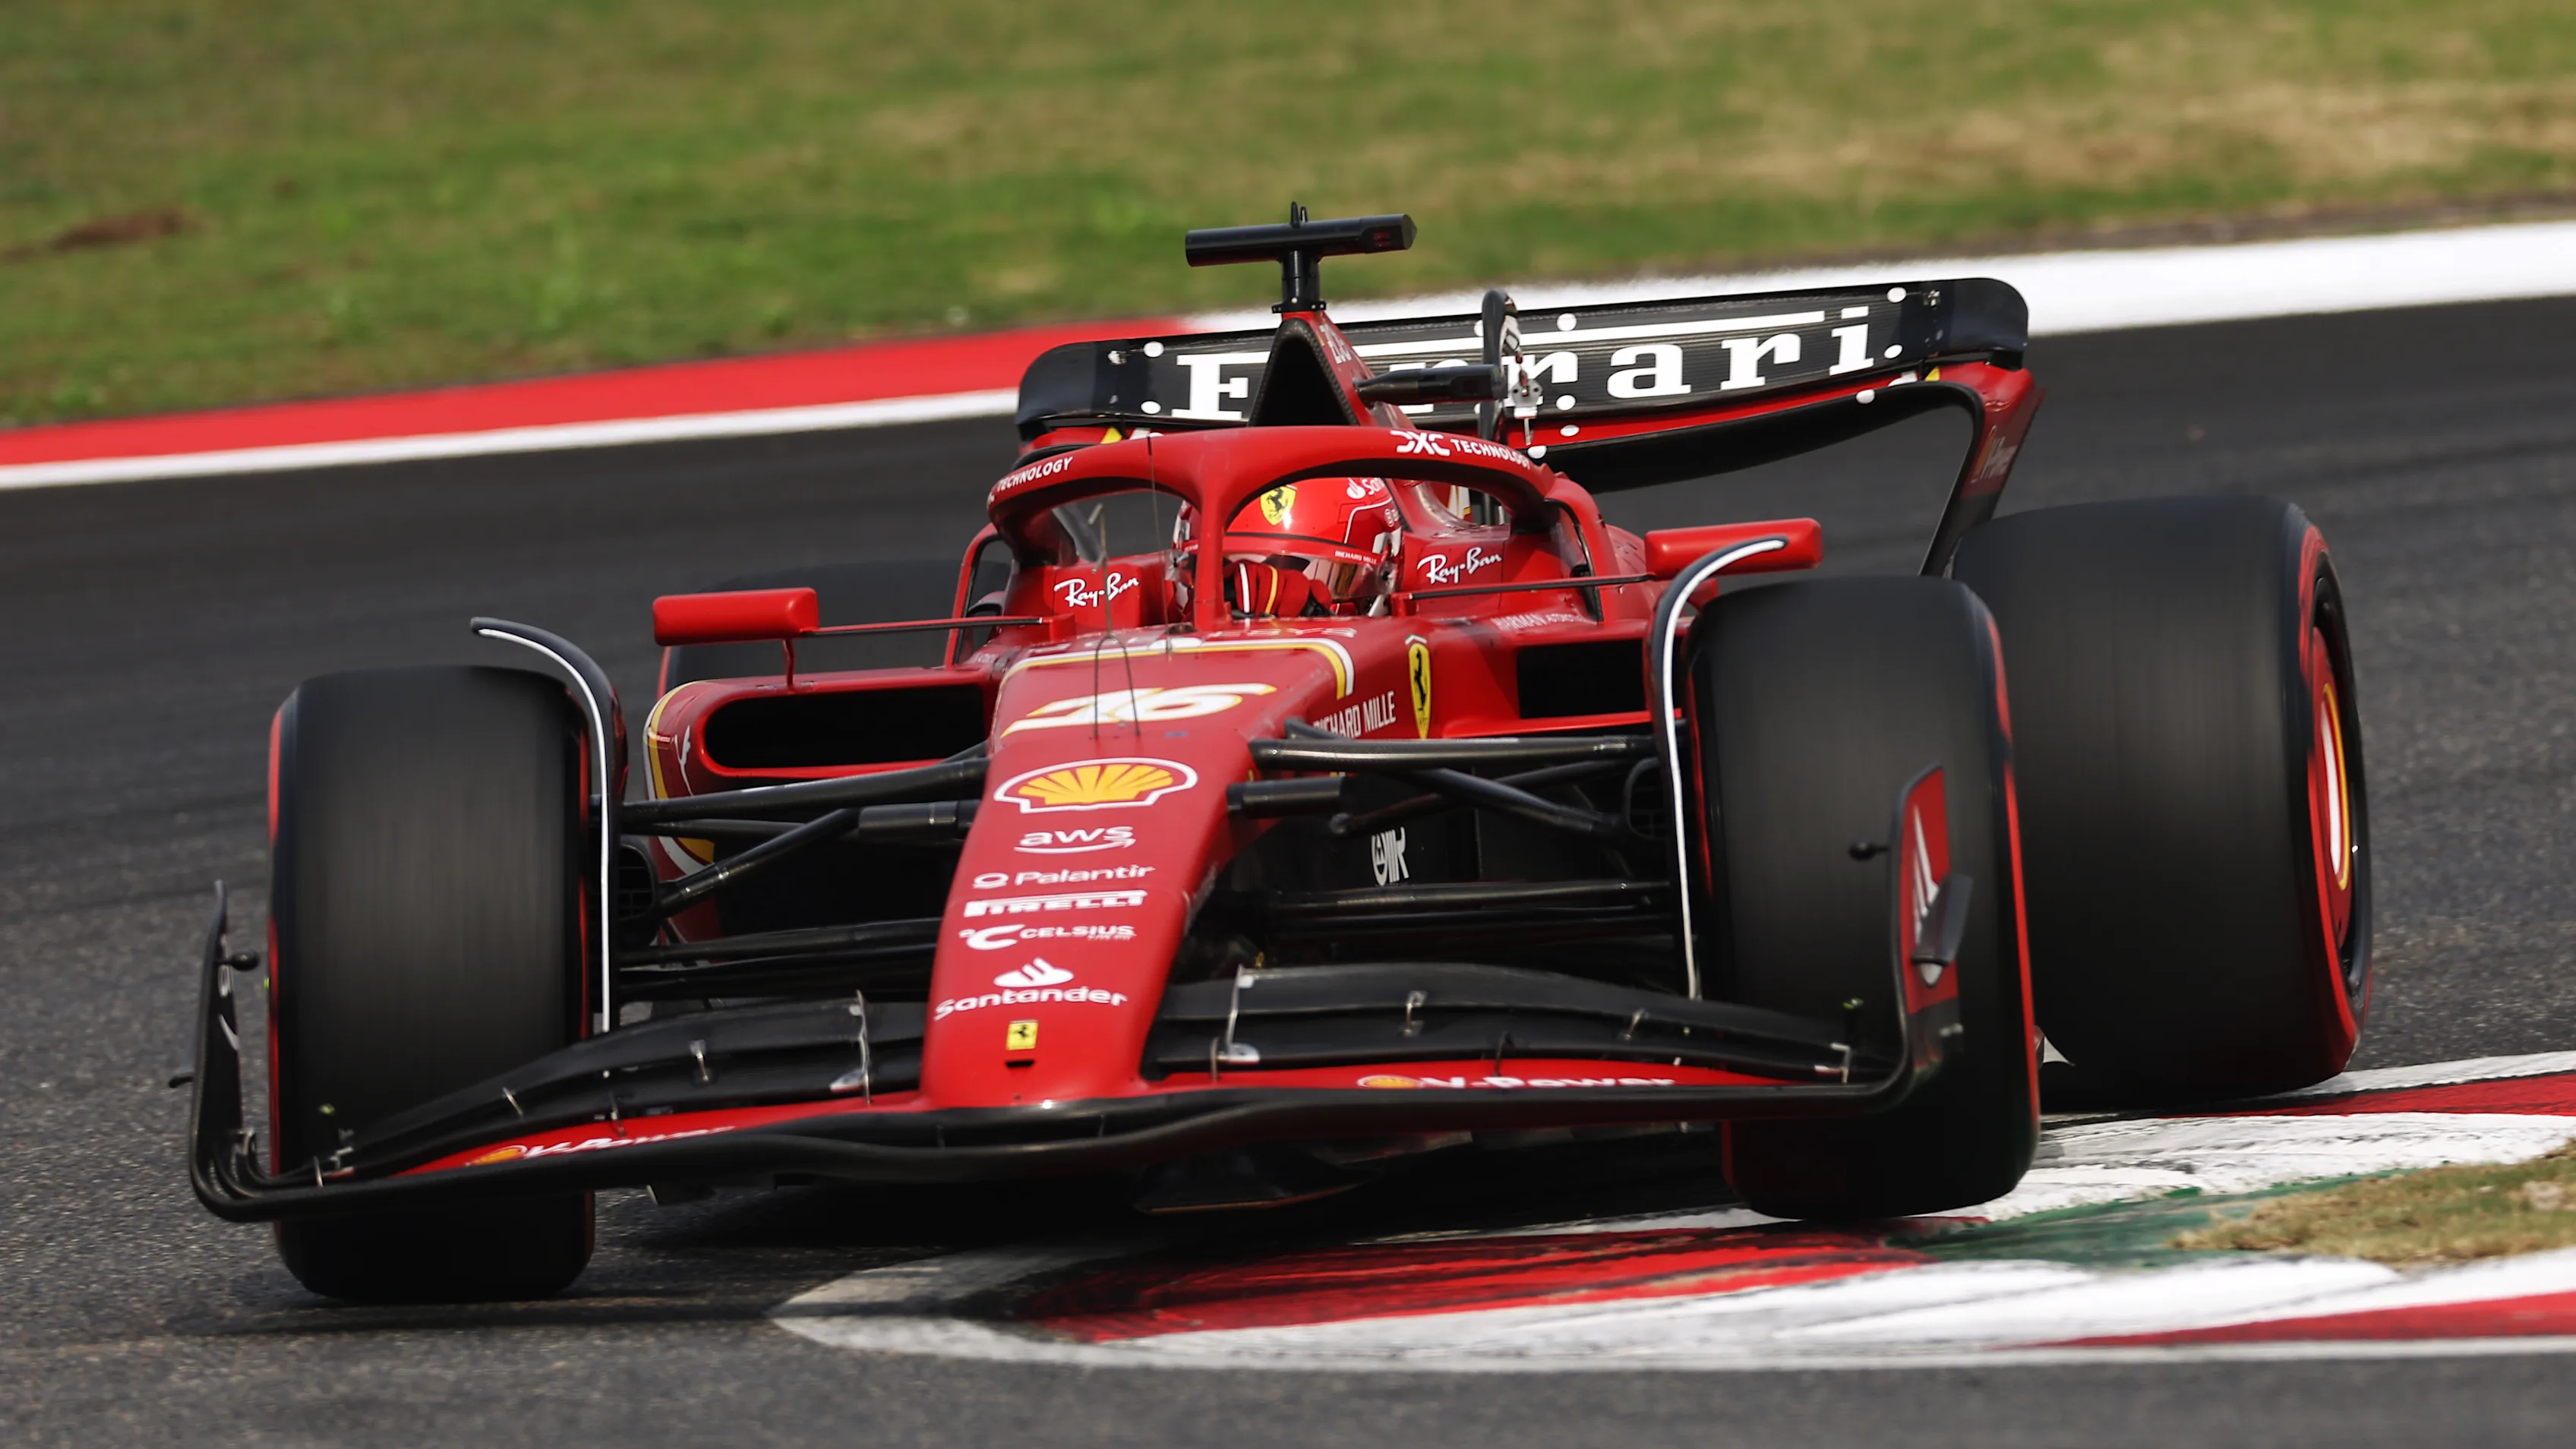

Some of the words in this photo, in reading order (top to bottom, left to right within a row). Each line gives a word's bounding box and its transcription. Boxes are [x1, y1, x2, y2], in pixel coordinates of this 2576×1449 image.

[1172, 306, 1874, 419] Frari
[1451, 439, 1530, 470] TECHNOLOGY
[996, 456, 1073, 492] TECHNOLOGY
[1417, 547, 1502, 584] Ray-Ban
[1053, 572, 1139, 608] Ray-Ban
[999, 683, 1277, 738] 16
[1363, 690, 1396, 733] MILLE
[1020, 826, 1133, 847] aws
[1015, 864, 1156, 886] Palantir
[964, 889, 1148, 917] PIRELLI
[1019, 925, 1135, 939] CELSIUS
[934, 987, 1128, 1021] Santander
